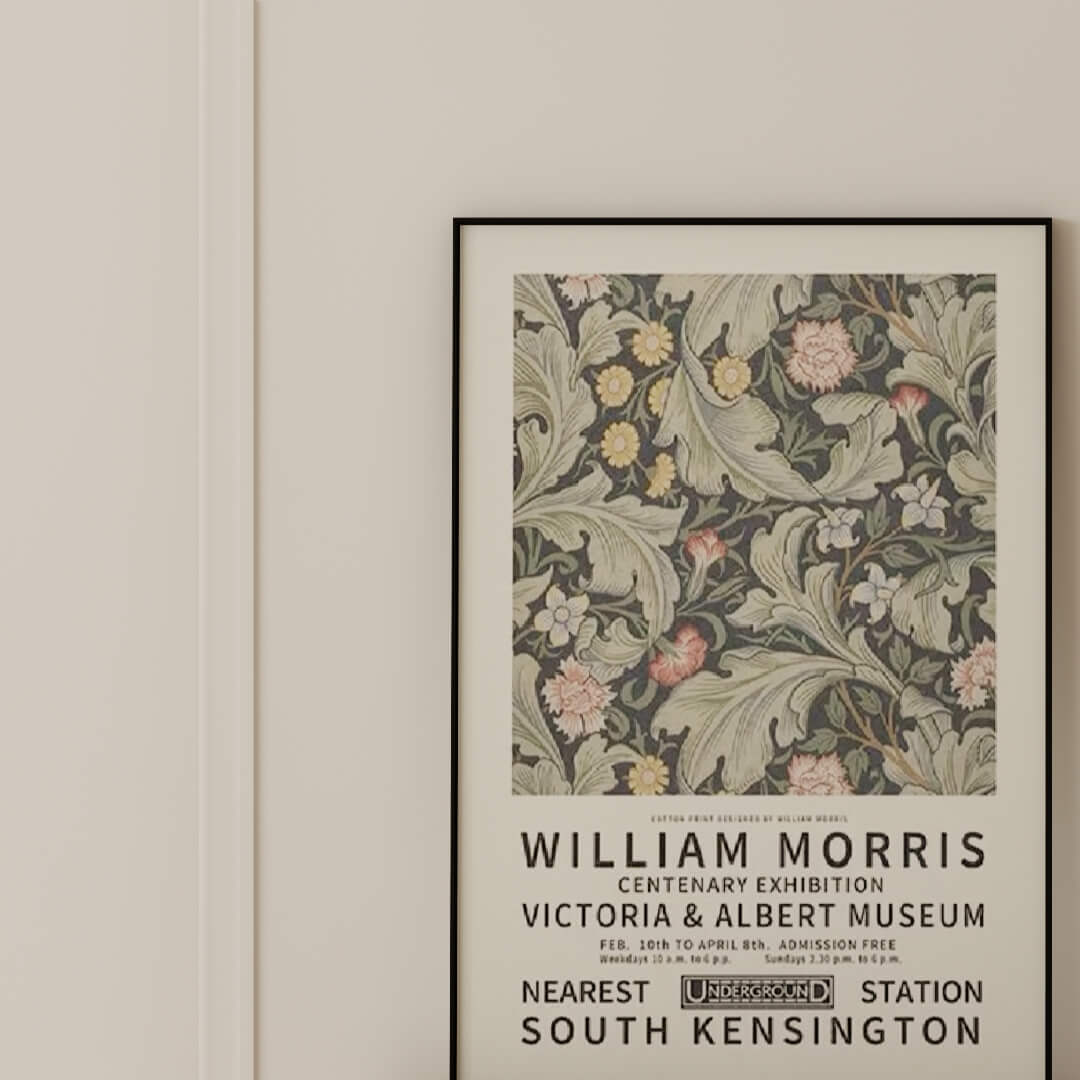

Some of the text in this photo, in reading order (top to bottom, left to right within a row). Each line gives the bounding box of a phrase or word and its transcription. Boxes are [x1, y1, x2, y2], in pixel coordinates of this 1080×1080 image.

[777, 815, 812, 823] WILLIAM
[521, 832, 984, 868] WILLIAM MORRIS
[619, 877, 882, 893] CENTENARY EXHIBITION
[523, 903, 984, 927] VICTORIA & ALBERT MUSEUM
[600, 939, 630, 951] FEB.
[640, 939, 670, 951] 10th
[698, 939, 738, 951] APRIL
[742, 939, 770, 951] 8th.
[779, 939, 857, 951] ADMISSION
[862, 939, 896, 951] FREE
[600, 955, 648, 965] Weekdays
[765, 955, 805, 965] Sundays
[523, 980, 982, 1003] NEAREST UNDERGROUND STATION
[522, 1016, 979, 1045] SOUTH KENSINGTON
